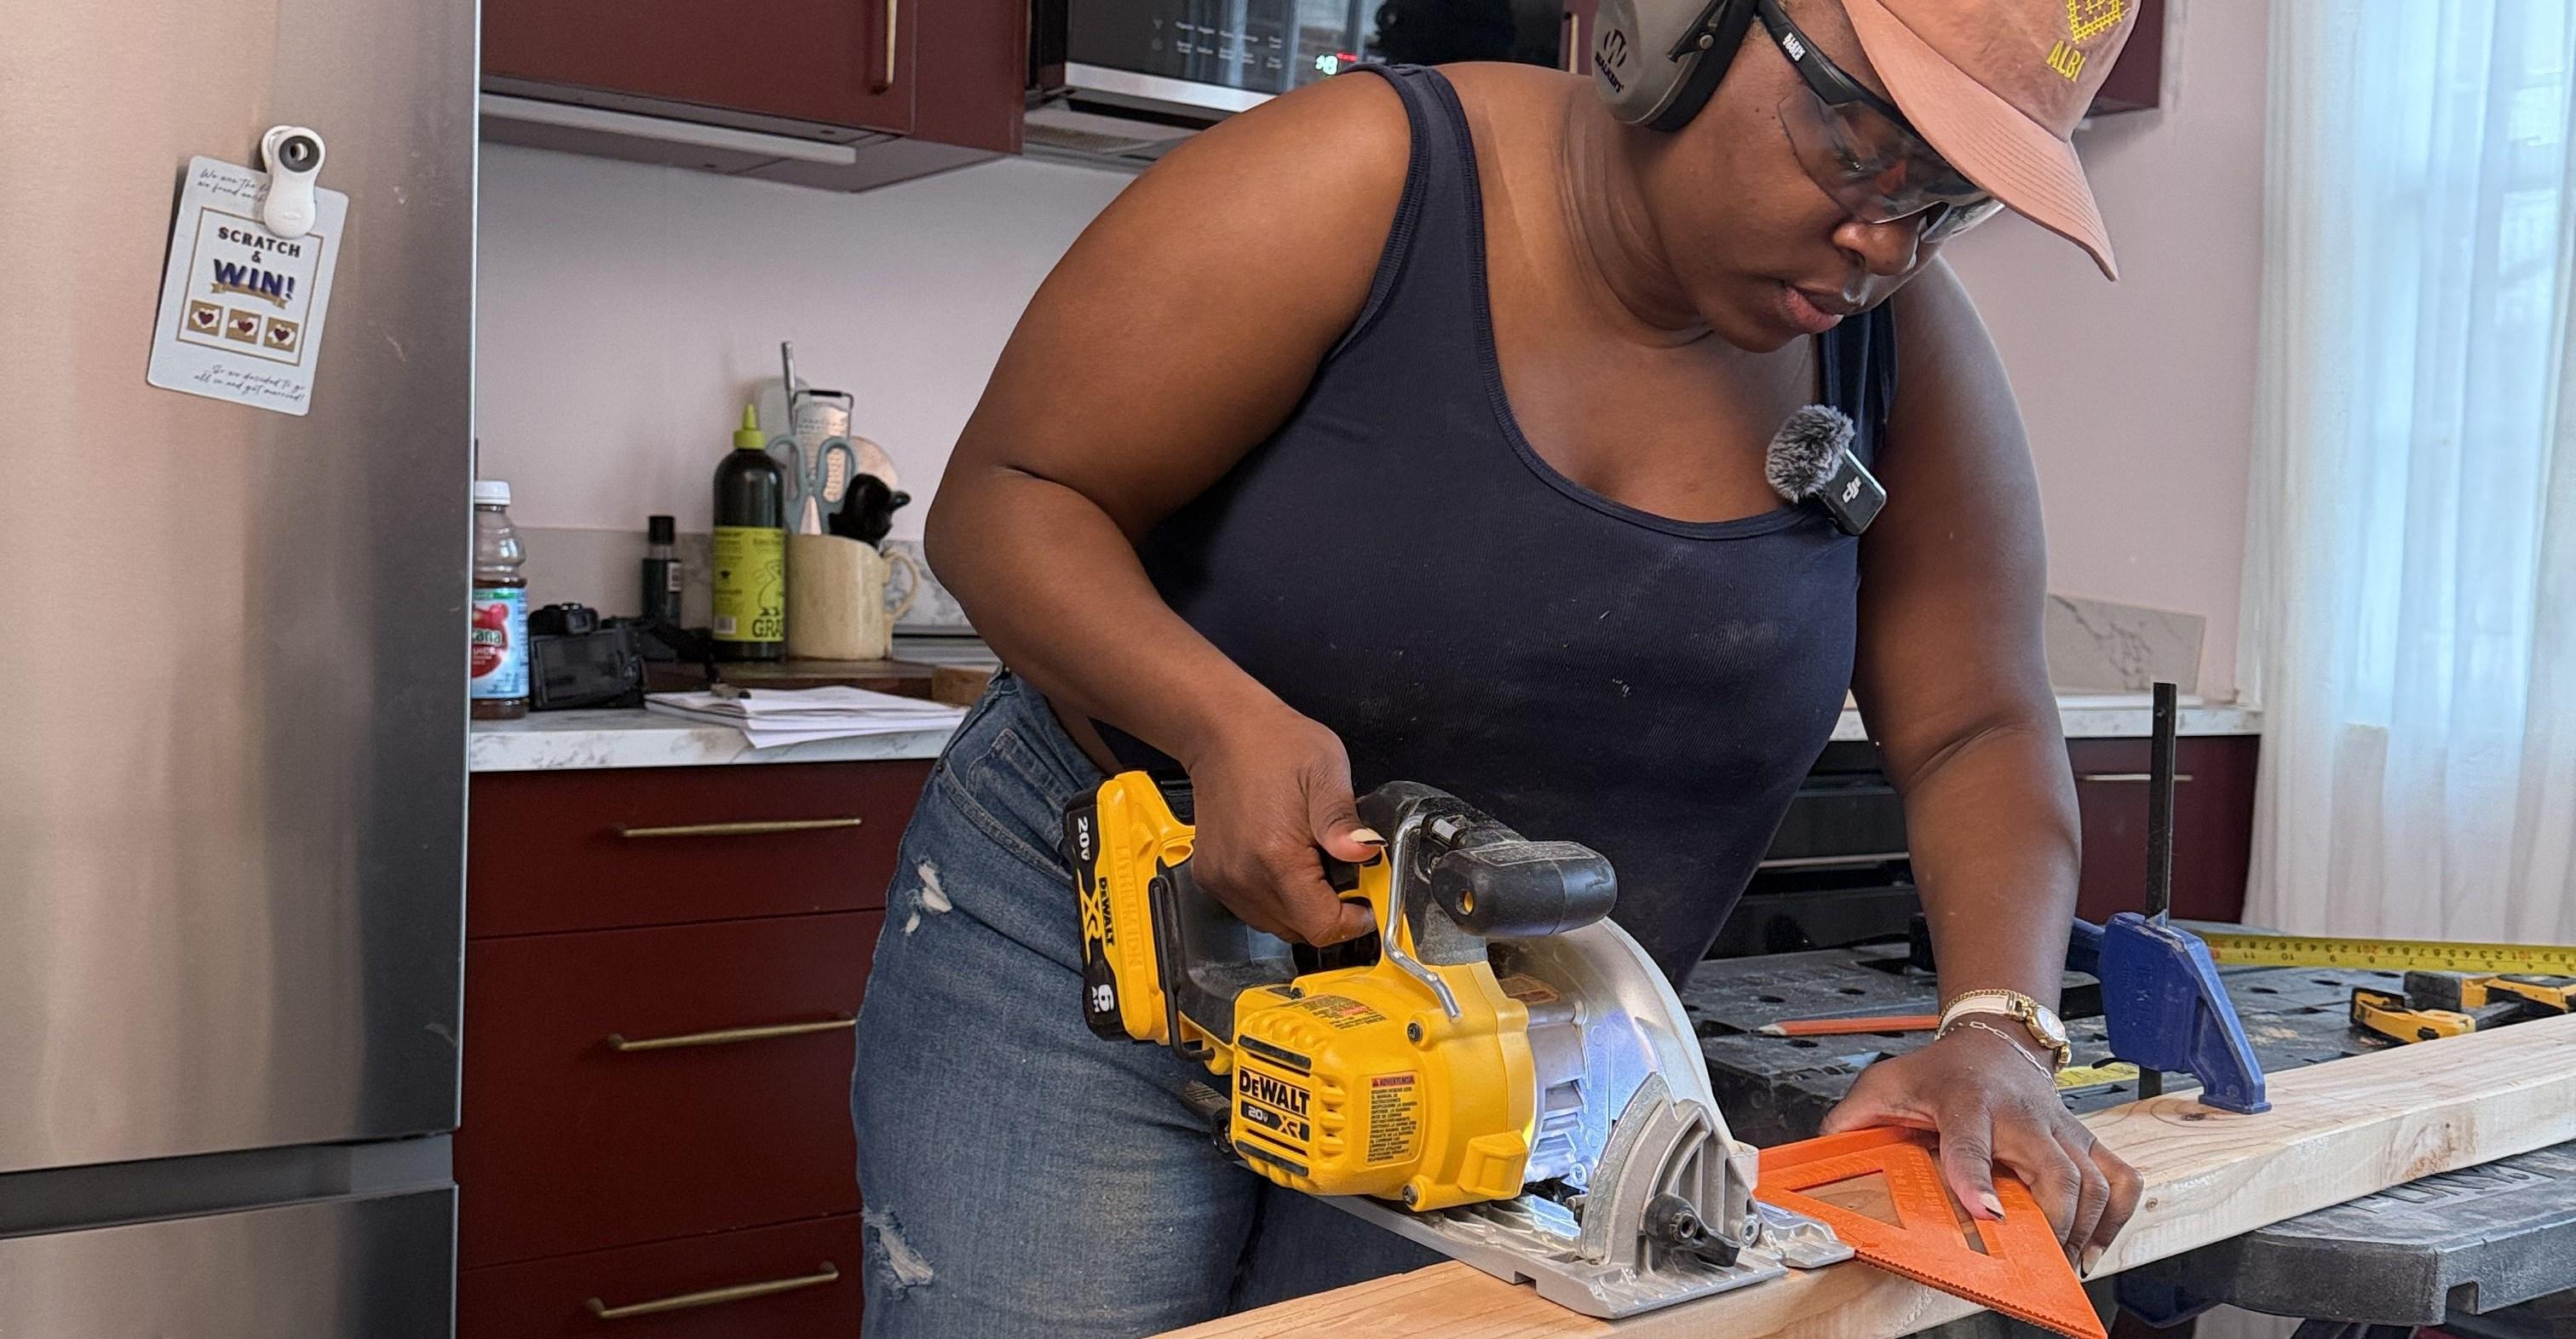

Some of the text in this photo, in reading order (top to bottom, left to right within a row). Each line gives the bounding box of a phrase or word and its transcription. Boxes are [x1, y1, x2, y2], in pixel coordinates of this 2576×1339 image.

[2046, 40, 2086, 83] ALBI
[218, 227, 301, 258] SCRATCH
[251, 250, 262, 263] &
[213, 258, 296, 301] WIN!
[752, 618, 784, 638] GRA
[1077, 816, 1091, 862] 20V
[1098, 984, 1115, 1012] 6
[1248, 1106, 1268, 1123] 20V
